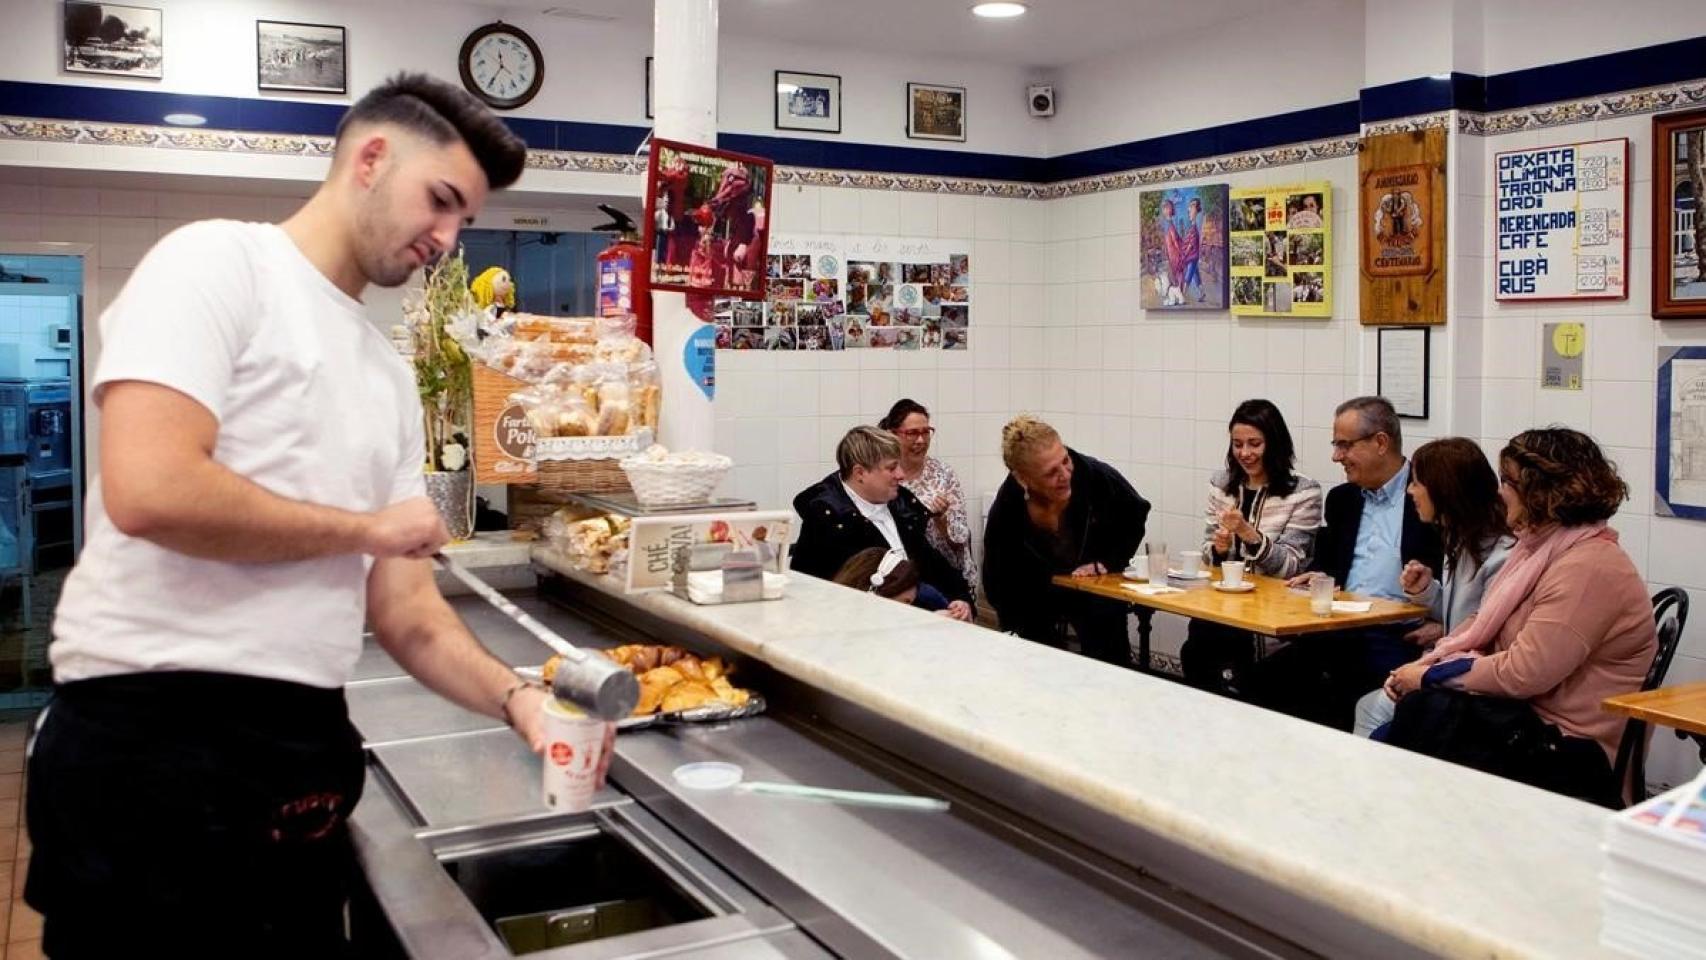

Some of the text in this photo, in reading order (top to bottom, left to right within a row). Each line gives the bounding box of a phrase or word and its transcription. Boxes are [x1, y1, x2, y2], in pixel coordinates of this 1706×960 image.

[1499, 149, 1574, 170] ORXATA
[1499, 211, 1576, 233] MERENGADA
[1499, 276, 1536, 295] RUS
